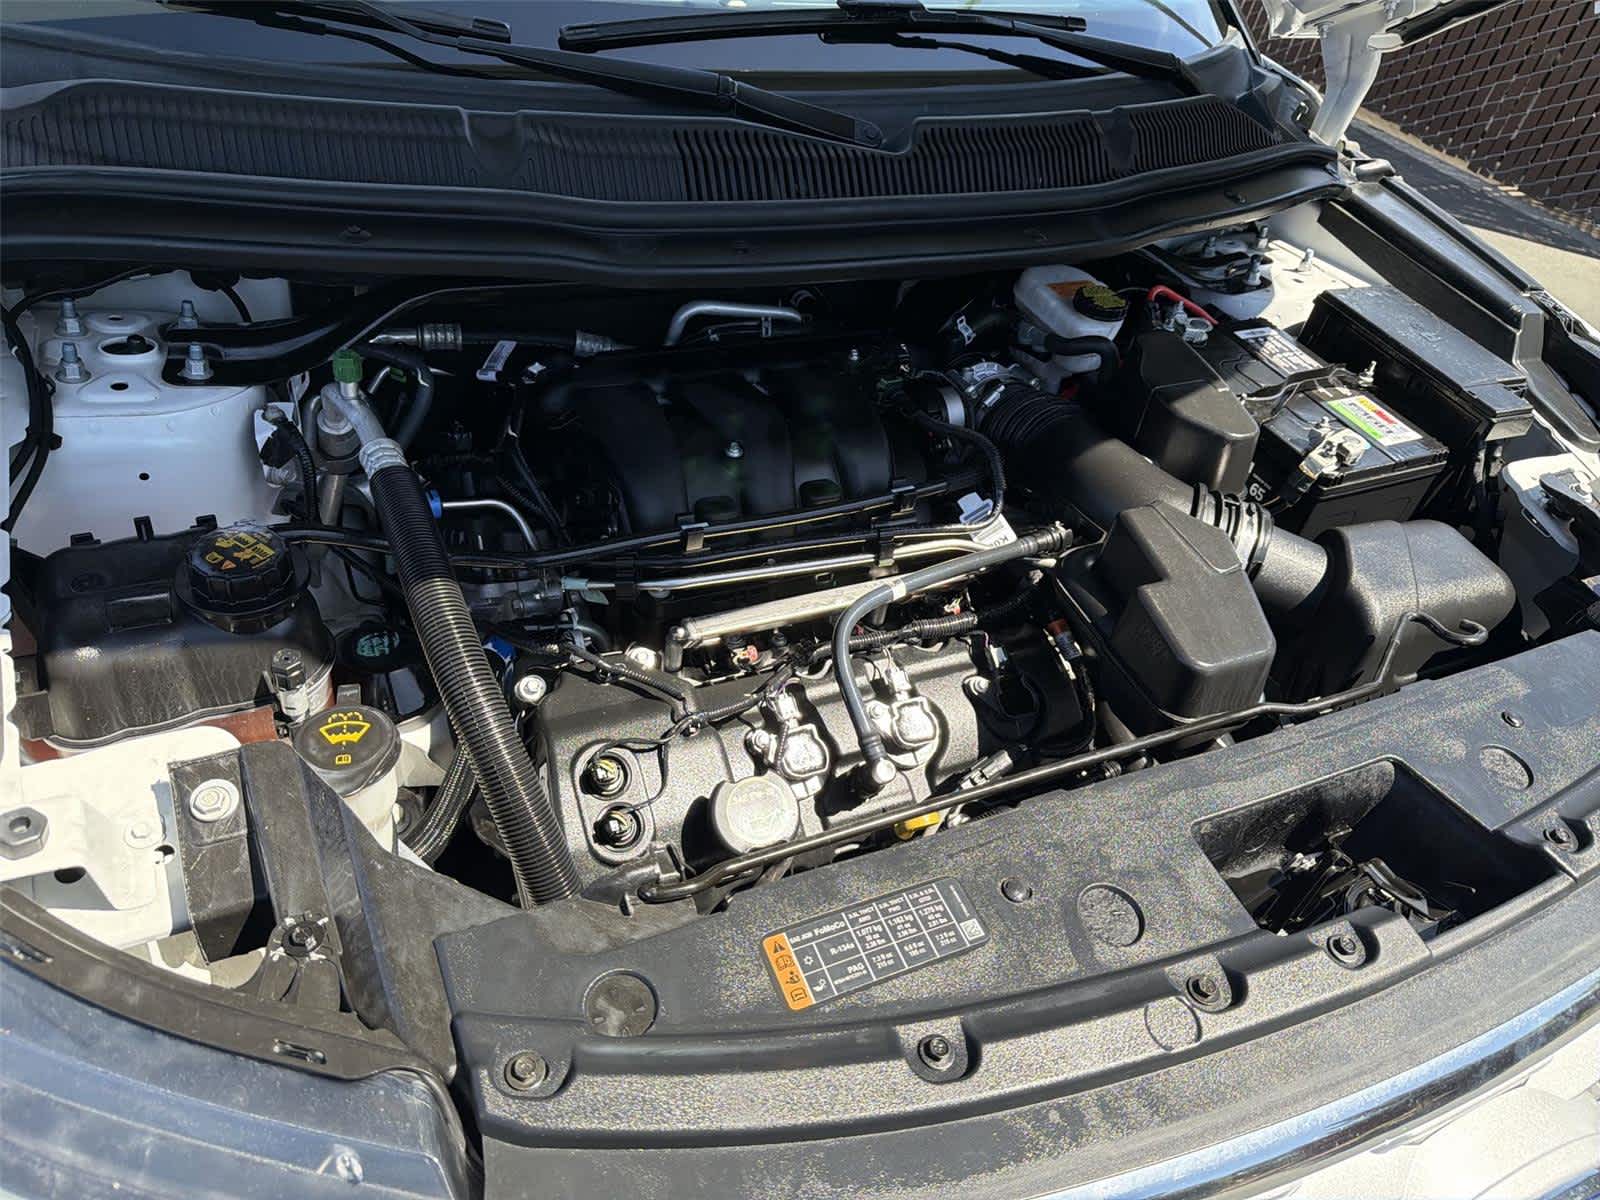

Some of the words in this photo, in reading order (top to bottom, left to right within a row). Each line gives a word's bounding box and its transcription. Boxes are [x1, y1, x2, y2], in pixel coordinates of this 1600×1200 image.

[1249, 483, 1266, 501] 65
[935, 904, 945, 913] kg
[905, 913, 915, 923] kg
[814, 921, 846, 936] FoMoCo
[857, 927, 873, 937] 1.077
[873, 924, 883, 933] kg
[830, 943, 855, 955] R-134a
[848, 962, 865, 974] PAG
